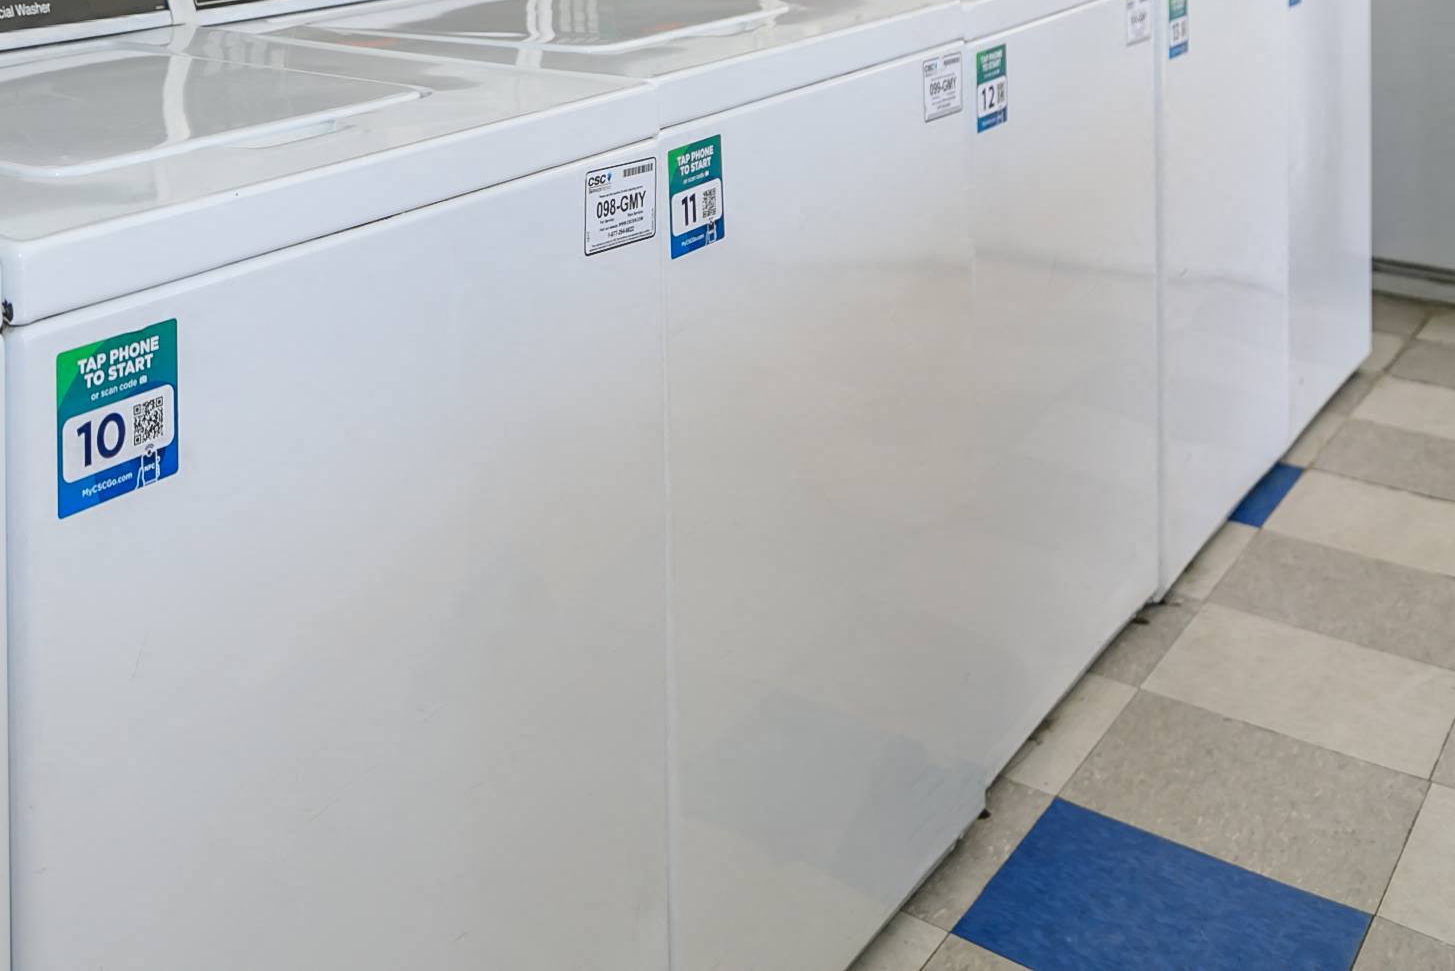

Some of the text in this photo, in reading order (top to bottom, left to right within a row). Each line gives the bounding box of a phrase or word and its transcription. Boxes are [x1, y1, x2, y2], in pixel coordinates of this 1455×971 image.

[14, 1, 51, 17] Washer
[982, 85, 995, 111] 12
[677, 145, 714, 166] TAP PHONE
[679, 156, 712, 176] TO START
[588, 174, 607, 187] CSC
[596, 190, 646, 218] 098-GMY
[681, 193, 697, 226] 11
[77, 336, 160, 374] TAP PHONE
[84, 354, 154, 389] TO START
[100, 386, 118, 398] scan
[119, 378, 137, 390] code
[77, 412, 126, 468] 10
[82, 472, 133, 497] MyCSCGo.com
